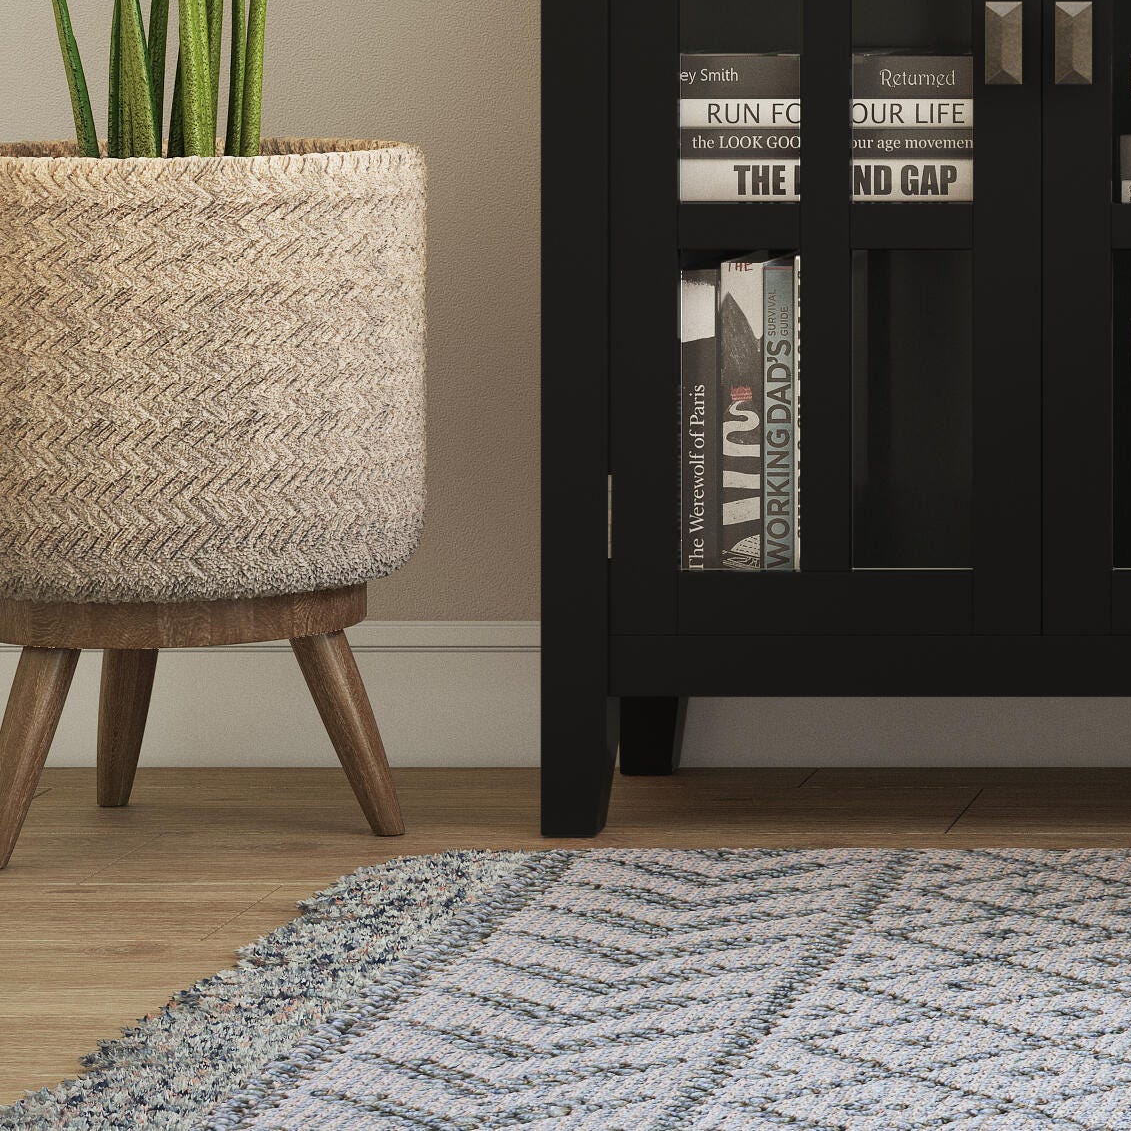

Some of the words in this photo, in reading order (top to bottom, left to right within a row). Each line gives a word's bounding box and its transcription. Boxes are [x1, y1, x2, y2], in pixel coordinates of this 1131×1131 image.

[680, 70, 696, 84] ey
[700, 68, 739, 82] Smith
[879, 68, 956, 88] Returned
[707, 103, 760, 124] RUN
[772, 103, 801, 124] FO
[852, 103, 904, 124] OUR
[915, 103, 965, 124] LIFE
[692, 135, 715, 149] the
[719, 136, 763, 149] LOOK
[766, 136, 801, 149] GOO
[852, 139, 873, 149] our
[877, 139, 901, 152] age
[905, 139, 974, 149] movemen
[733, 165, 787, 196] THE
[853, 165, 892, 196] ND
[900, 165, 958, 196] GAP
[767, 289, 777, 336] SURVIVAL
[780, 306, 789, 336] GUIDE
[688, 384, 706, 426] Paris
[689, 429, 705, 449] of
[688, 451, 705, 533] Werewolf
[688, 538, 704, 570] The
